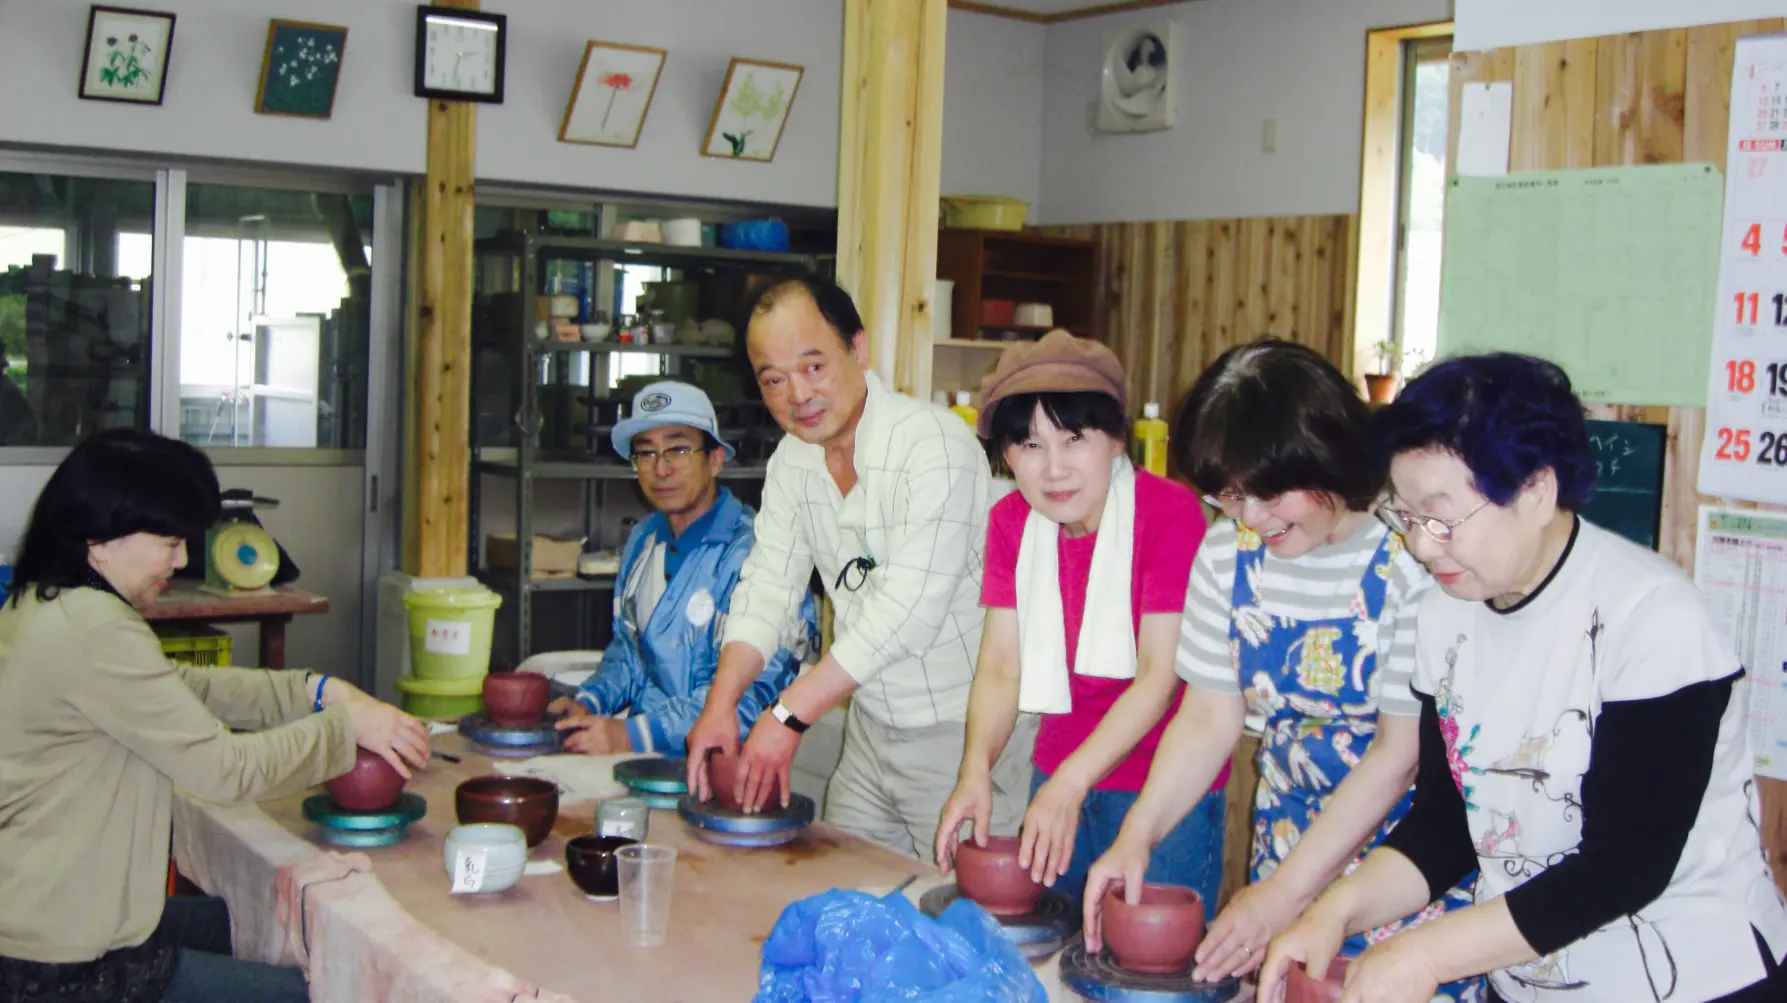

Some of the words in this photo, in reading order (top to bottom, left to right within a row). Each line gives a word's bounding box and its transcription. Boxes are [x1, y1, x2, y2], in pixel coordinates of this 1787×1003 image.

[1754, 140, 1778, 151] SUN
[1747, 158, 1769, 178] 27
[1741, 223, 1762, 257] 4
[1734, 291, 1760, 326] 11
[1725, 360, 1756, 394] 18
[1715, 427, 1752, 463] 25
[1756, 431, 1787, 467] 26
